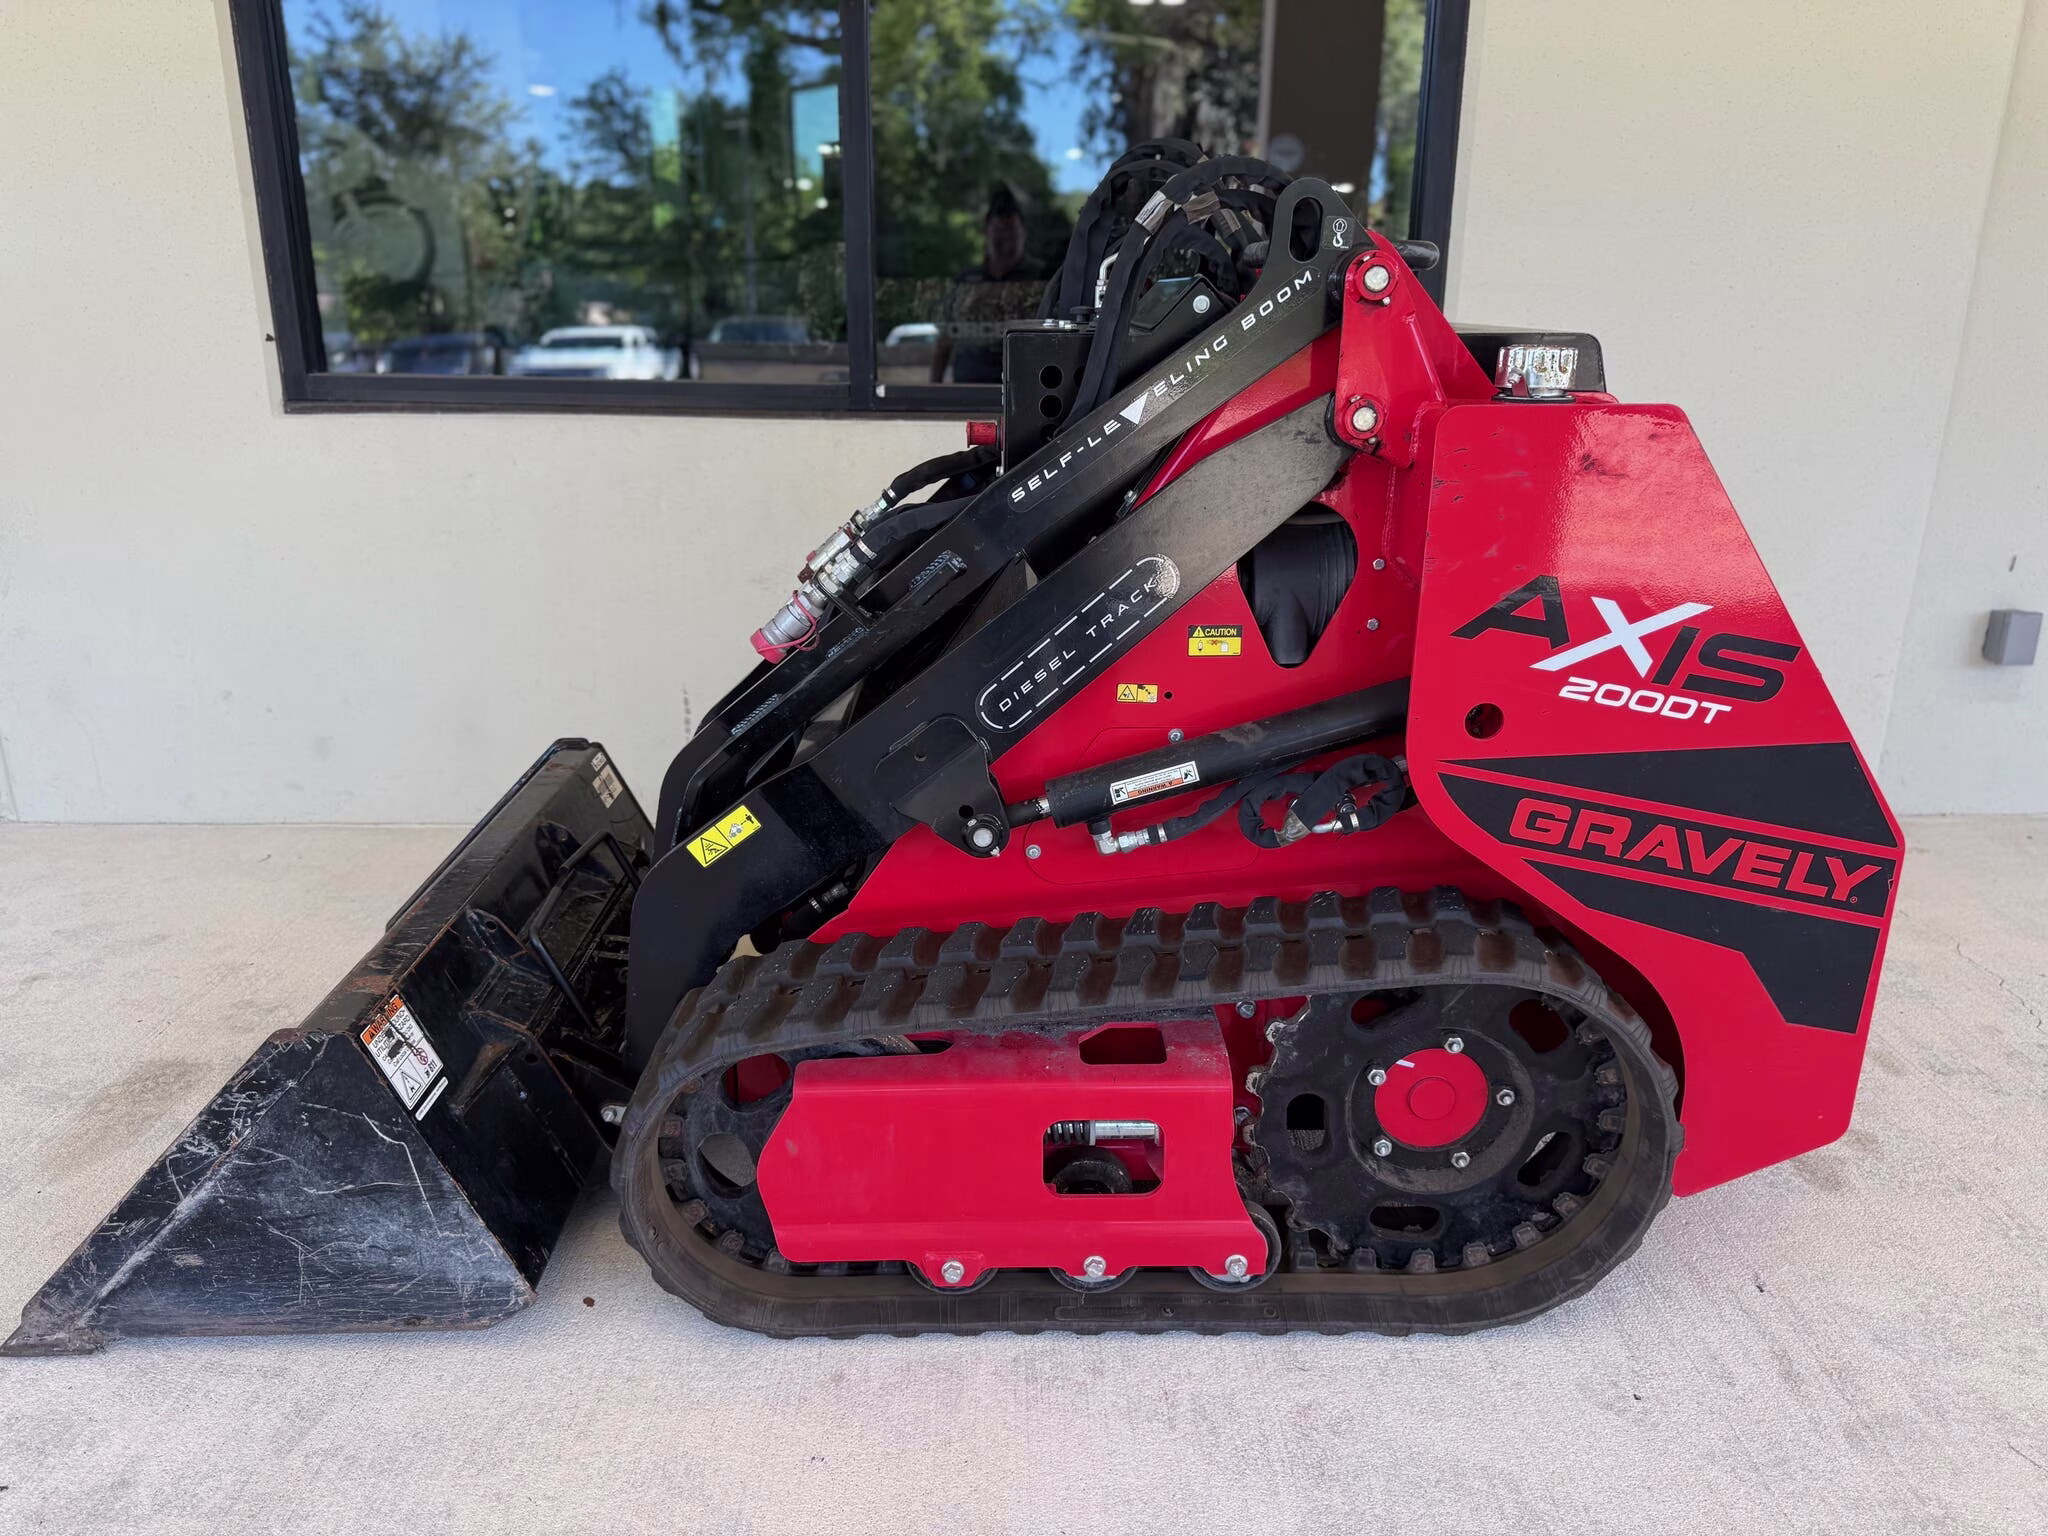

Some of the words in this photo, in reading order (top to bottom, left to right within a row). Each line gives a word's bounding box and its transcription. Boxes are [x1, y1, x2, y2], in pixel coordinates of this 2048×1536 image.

[1241, 270, 1312, 331] BOOM
[999, 650, 1076, 711] DIESEL
[1086, 577, 1157, 637] TRACK
[1205, 628, 1237, 636] CAUTION
[1450, 574, 1801, 702] AXIS
[1558, 676, 1732, 724] 200DT
[1137, 783, 1167, 795] WARNING
[1508, 797, 1882, 901] GRAVELY
[370, 1000, 399, 1035] WARING
